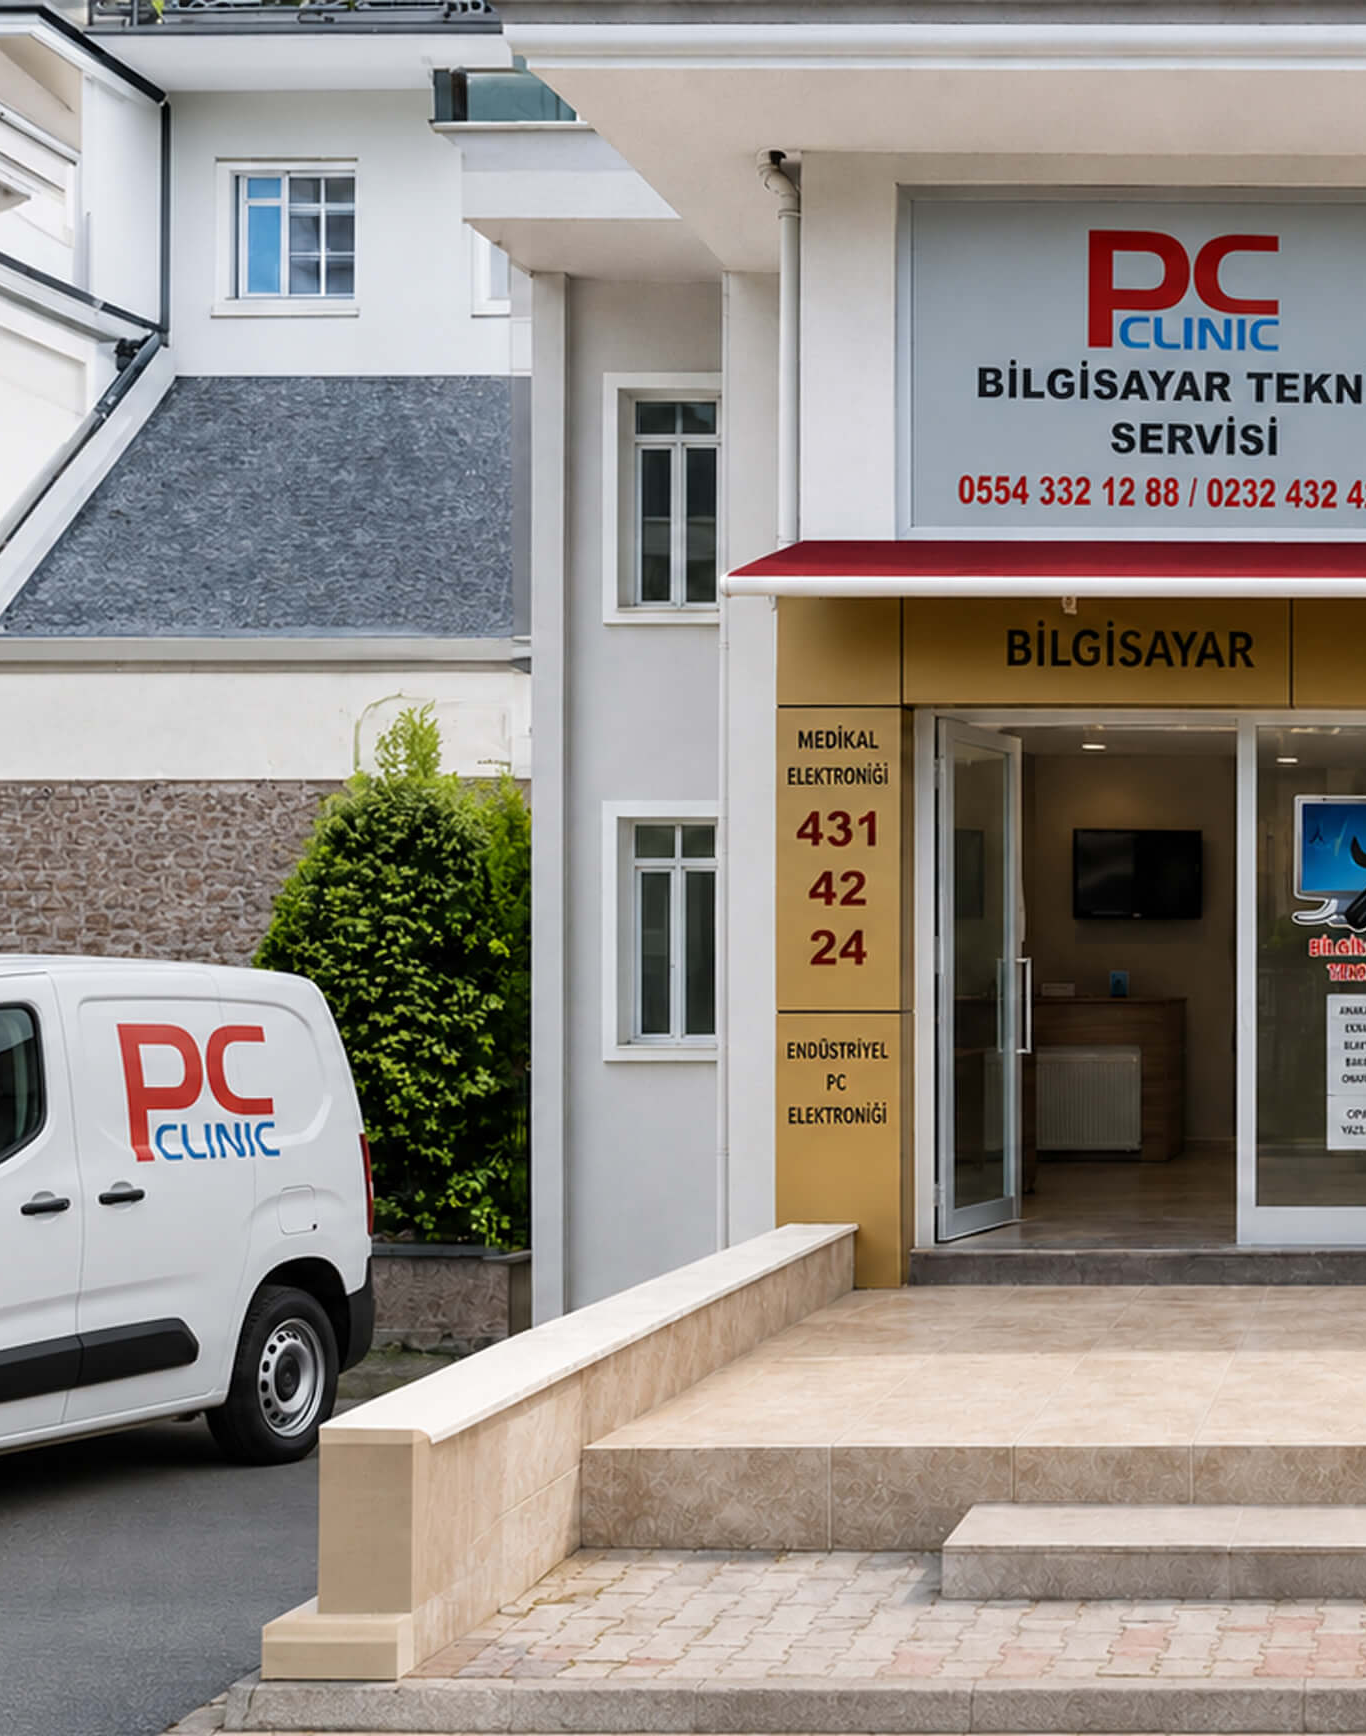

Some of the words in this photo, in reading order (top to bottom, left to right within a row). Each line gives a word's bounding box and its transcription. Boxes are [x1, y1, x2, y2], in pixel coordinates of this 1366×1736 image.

[1088, 229, 1279, 348] PC
[1119, 316, 1279, 351] CLINIC
[977, 360, 1232, 402] BİLGİSAYAR
[1111, 417, 1278, 456] SERVİSİ
[958, 475, 1029, 505] 0554
[1039, 476, 1091, 506] 332
[1102, 477, 1136, 506] 12
[1145, 477, 1180, 507] 88
[1188, 477, 1198, 507] /
[1207, 478, 1276, 508] 0232
[1285, 479, 1337, 509] 432
[1006, 621, 1255, 669] BİLGİSAYAR
[798, 725, 879, 749] MEDİKAL
[796, 811, 877, 847] 431
[808, 871, 867, 906] 42
[810, 930, 867, 965] 24
[117, 1023, 274, 1162] PC
[826, 1073, 847, 1091] PC
[155, 1121, 280, 1161] CLINIC
